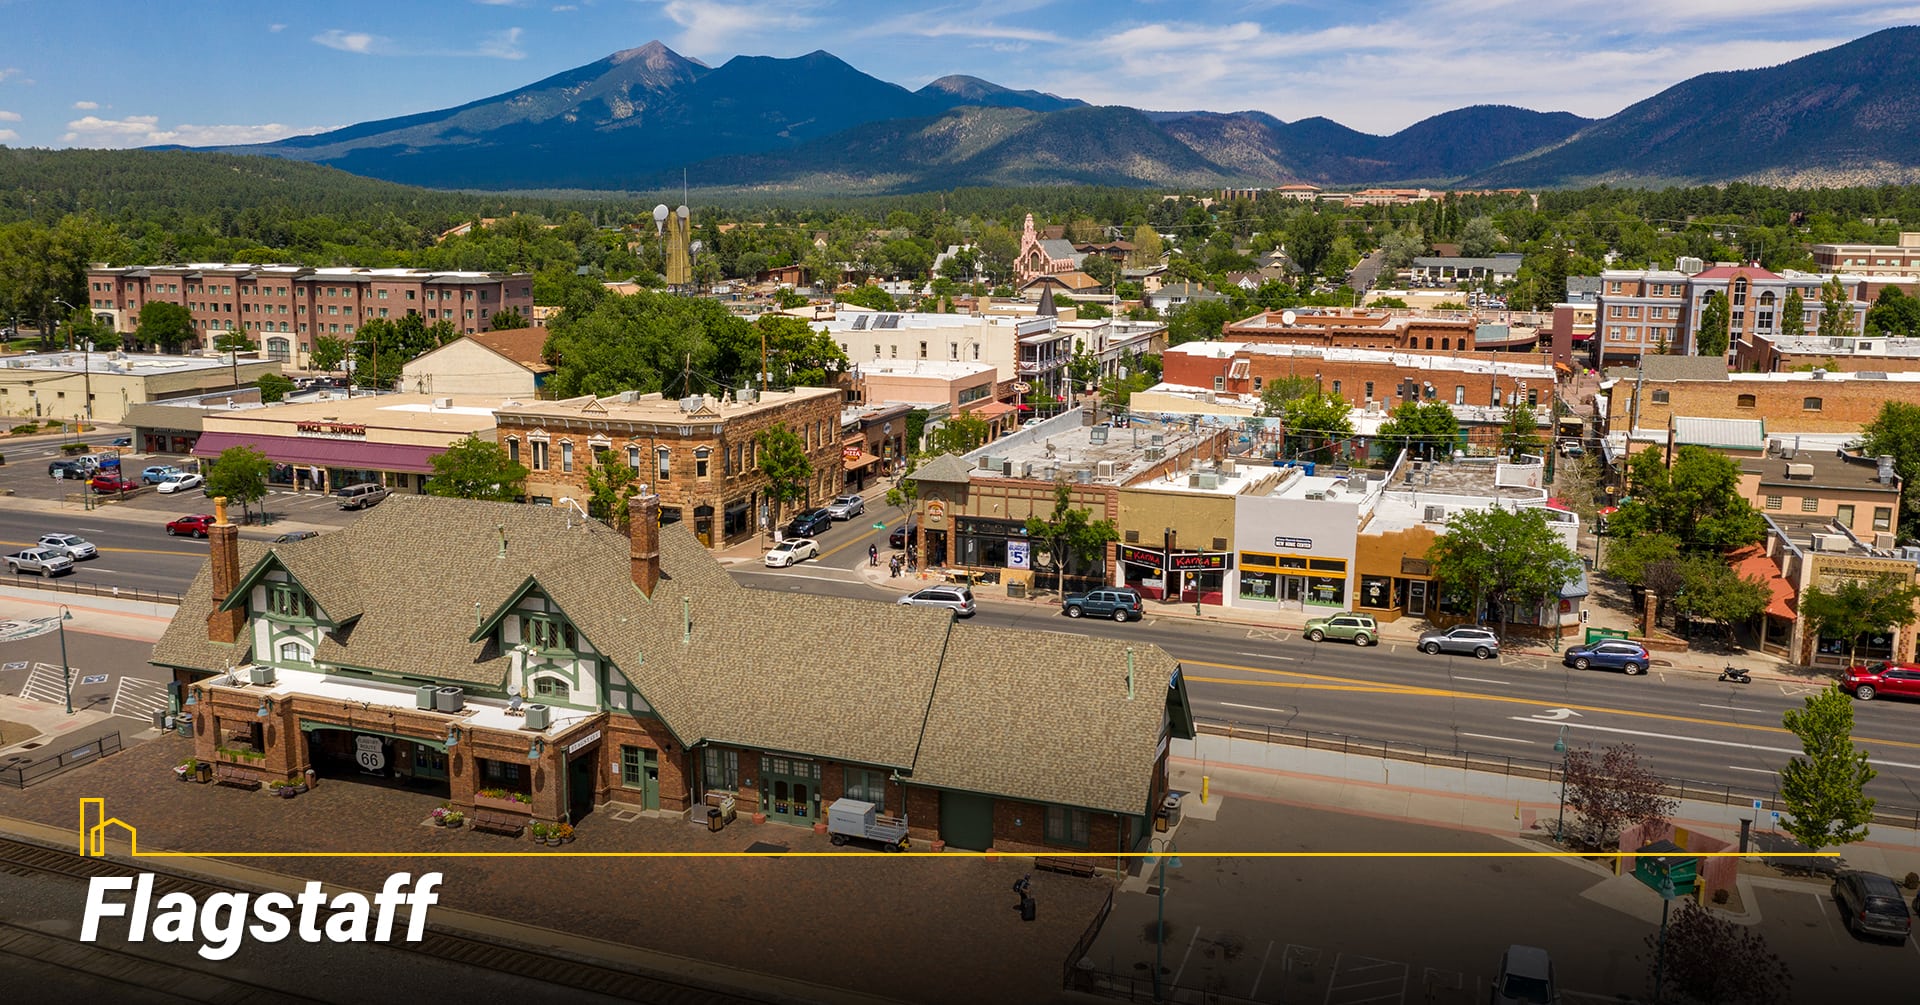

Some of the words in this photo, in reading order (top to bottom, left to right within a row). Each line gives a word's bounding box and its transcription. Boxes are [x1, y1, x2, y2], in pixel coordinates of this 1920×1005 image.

[297, 424, 321, 433] PEACE
[330, 425, 366, 436] SURPLUS
[843, 449, 860, 457] PIZZA
[361, 752, 378, 767] 66
